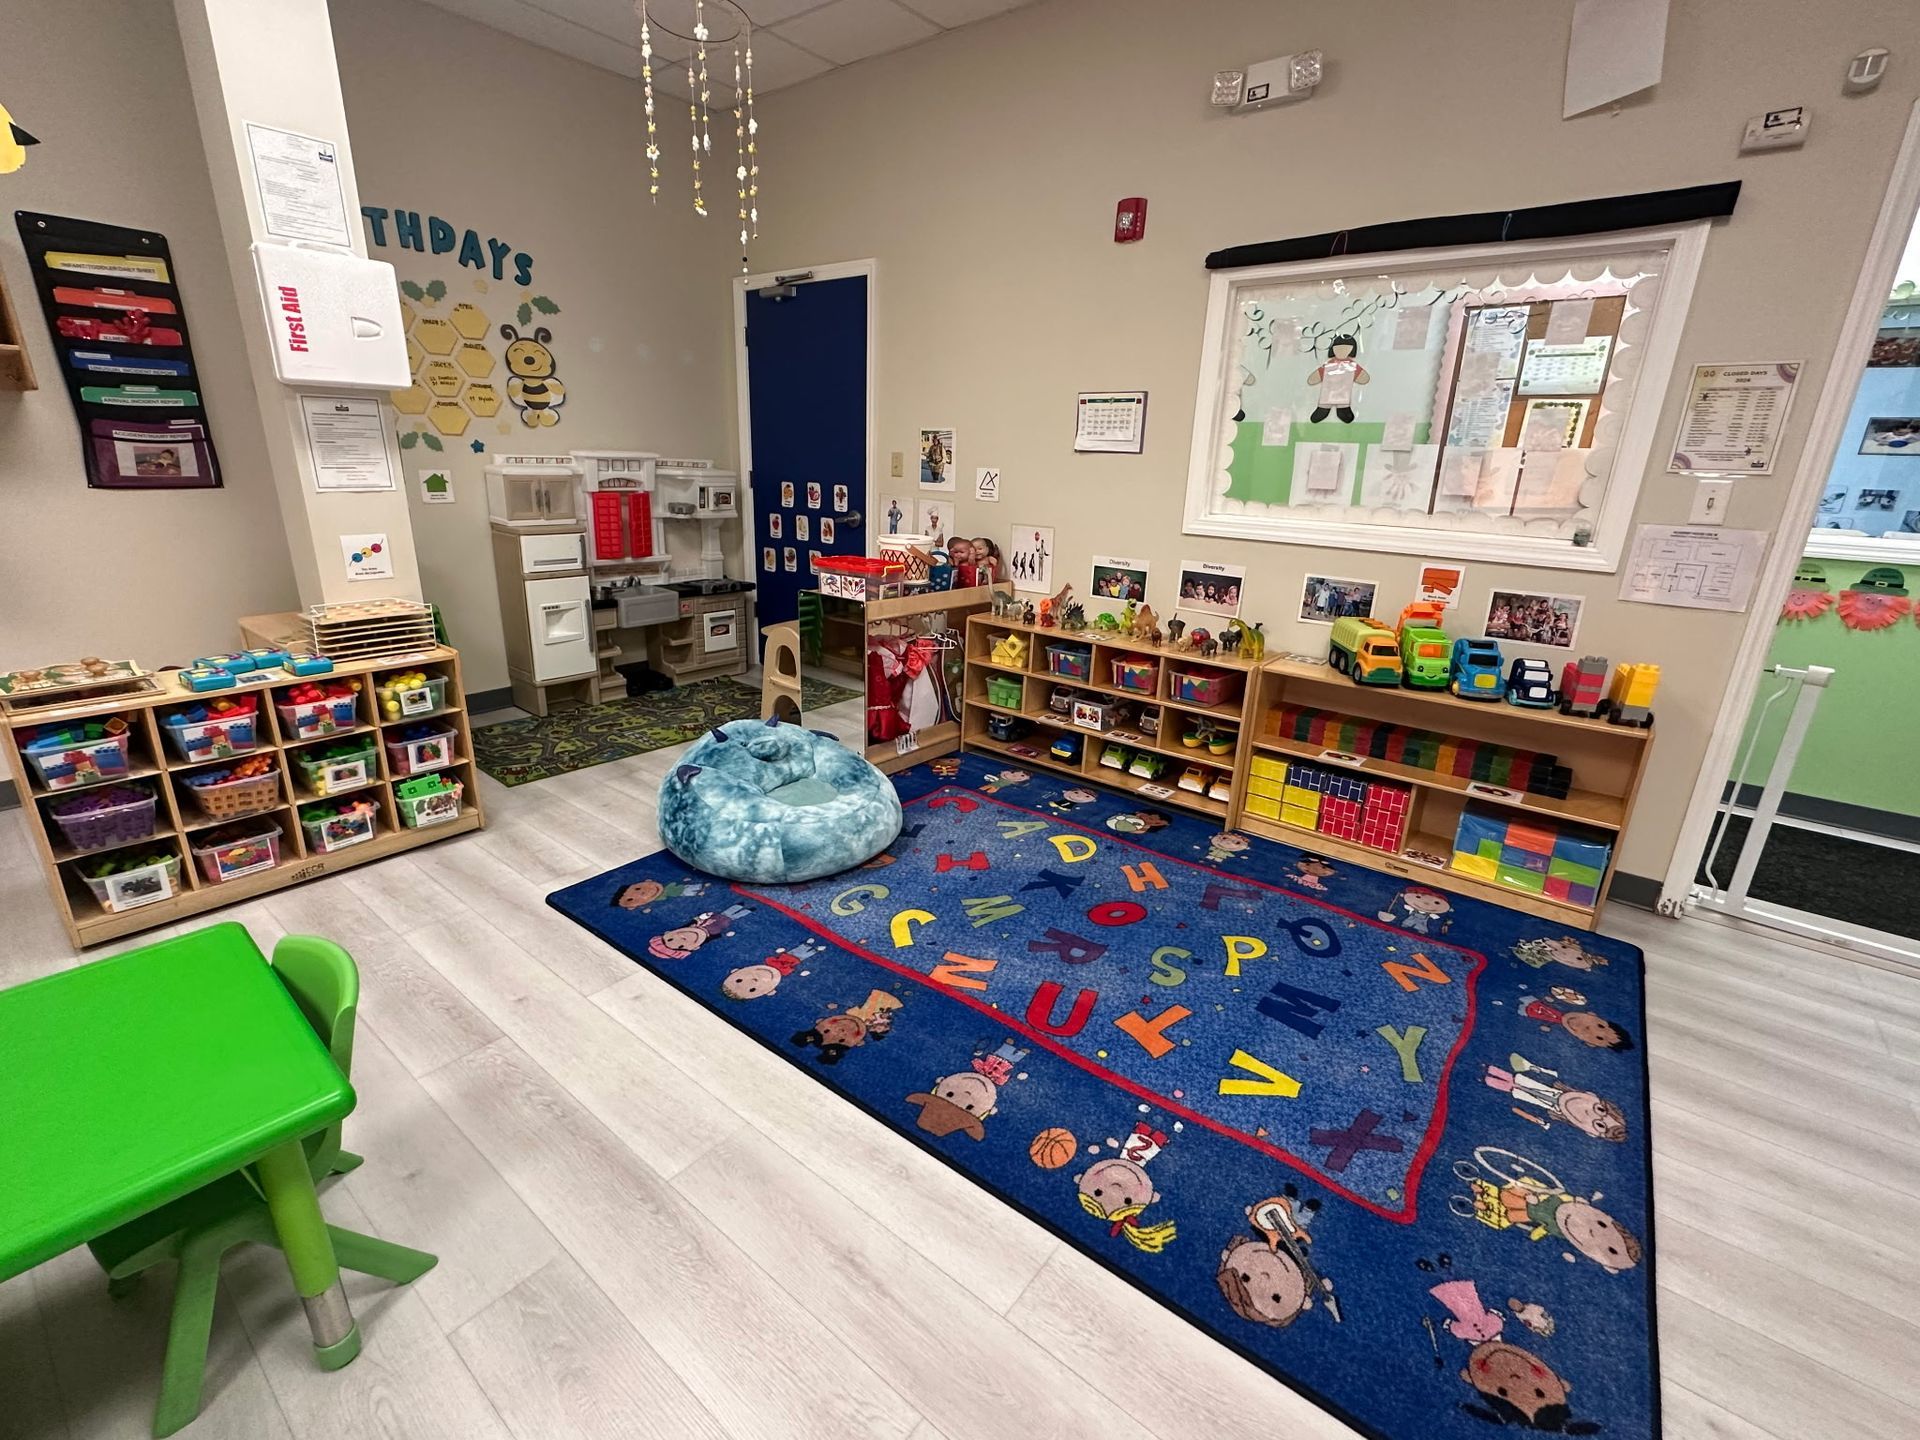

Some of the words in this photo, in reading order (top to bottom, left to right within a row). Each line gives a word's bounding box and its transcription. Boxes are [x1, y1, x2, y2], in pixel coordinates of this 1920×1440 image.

[361, 206, 534, 286] THDAYS
[278, 286, 302, 314] Aid
[286, 316, 309, 353] First
[1109, 558, 1131, 568] Diversity
[1202, 563, 1225, 572] Diversity
[996, 820, 1051, 839] A
[1048, 834, 1098, 863] D
[1020, 868, 1085, 896] K
[1120, 861, 1170, 892] H
[830, 883, 891, 917] G
[1088, 901, 1148, 926] O
[1276, 916, 1342, 958] Q
[1148, 946, 1192, 987] S
[1222, 934, 1268, 976] P
[1026, 980, 1100, 1037] U
[1376, 1024, 1428, 1083] Y
[1218, 1048, 1302, 1098] V
[1310, 1108, 1404, 1173] X
